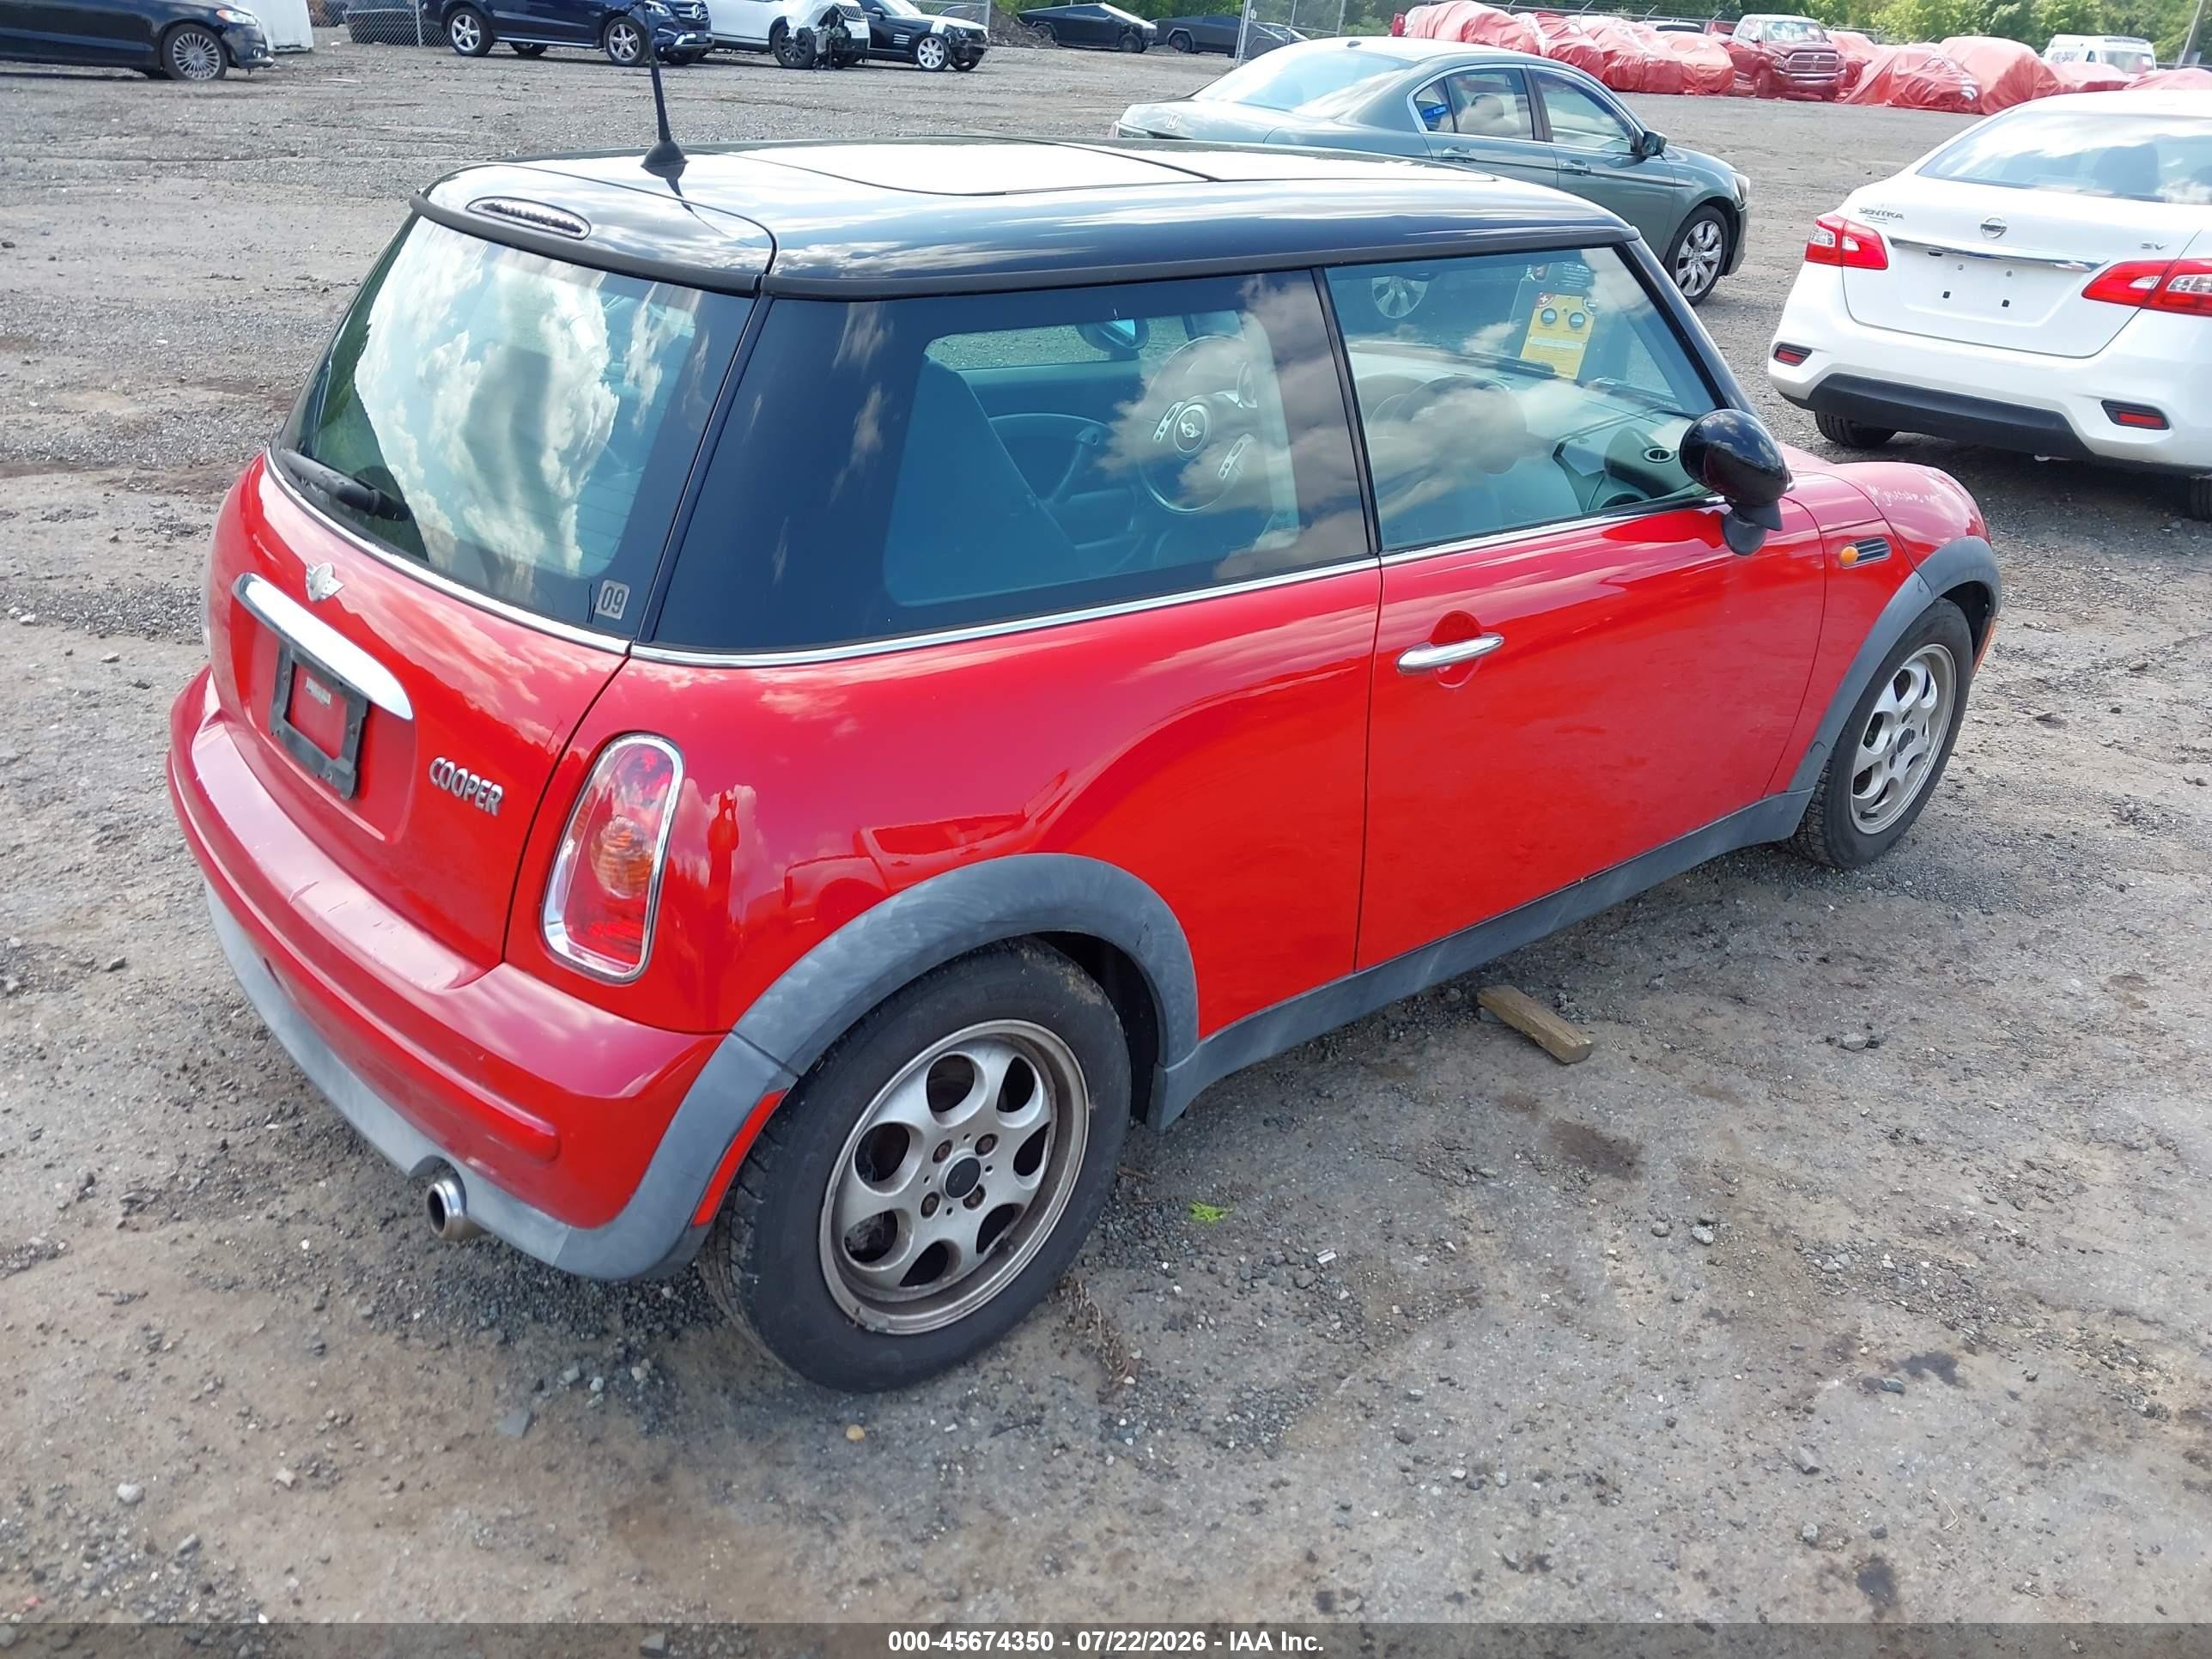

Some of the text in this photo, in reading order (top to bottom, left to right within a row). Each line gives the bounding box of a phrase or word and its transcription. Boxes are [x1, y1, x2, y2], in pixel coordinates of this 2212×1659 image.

[1858, 207, 1905, 220] SENTRA
[2141, 242, 2169, 251] SV
[601, 585, 625, 614] 09
[428, 757, 504, 817] COOPER
